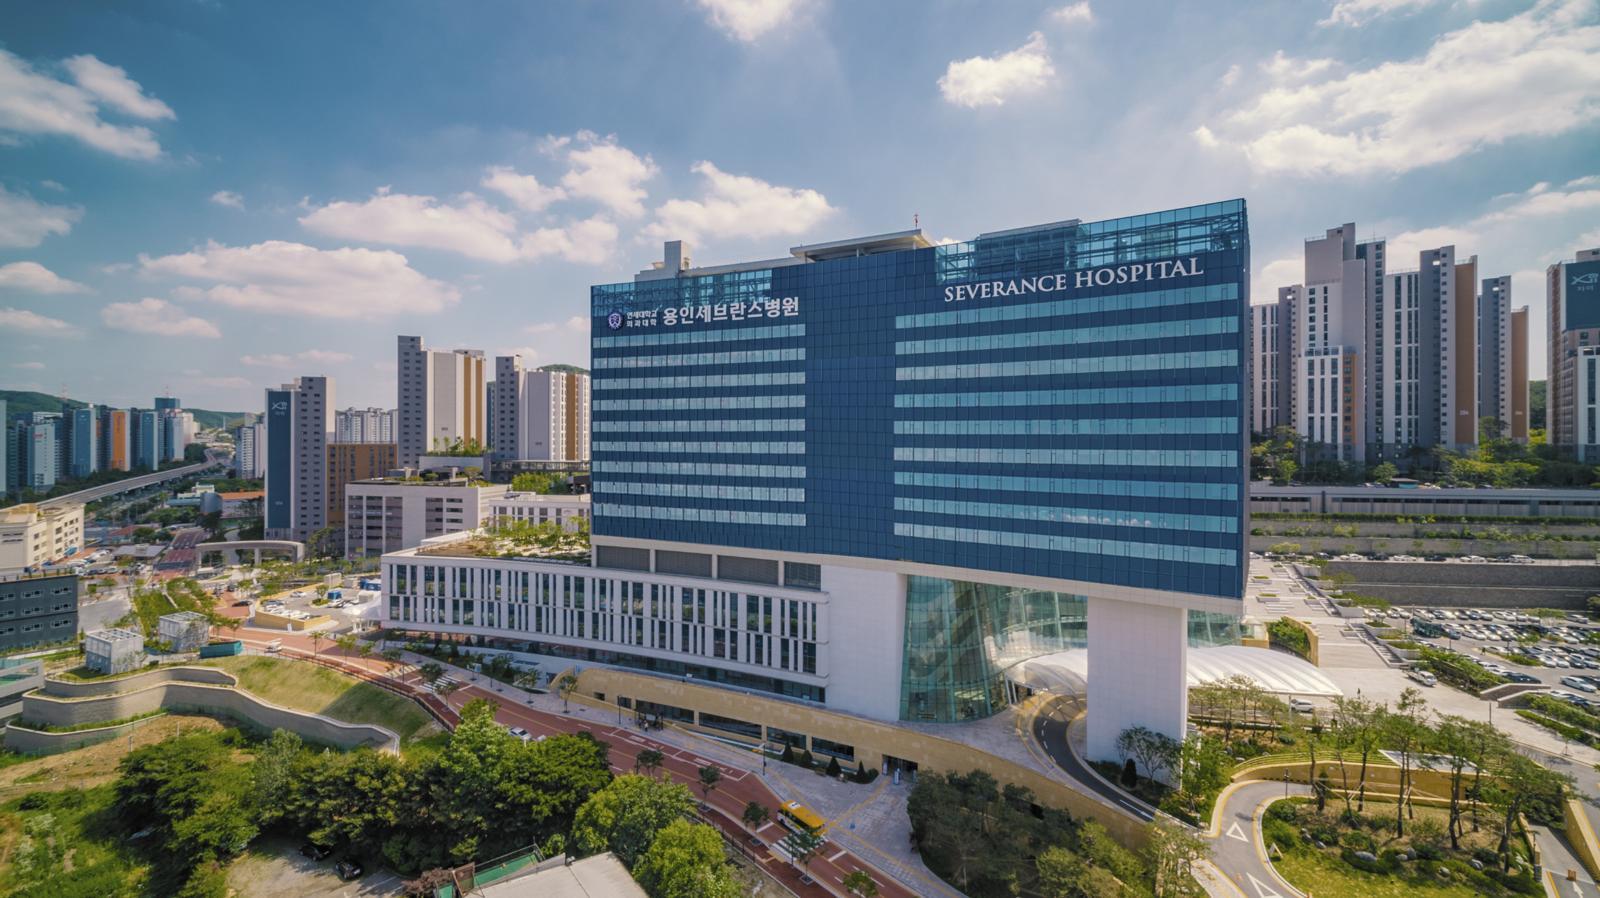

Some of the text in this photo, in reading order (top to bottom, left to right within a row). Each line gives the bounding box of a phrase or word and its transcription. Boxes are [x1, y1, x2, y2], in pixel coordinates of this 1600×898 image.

[944, 257, 1204, 302] SEVERANCE HOSPITAL
[626, 310, 657, 320] 연세대학교
[662, 296, 799, 326] 용인세브란스병원
